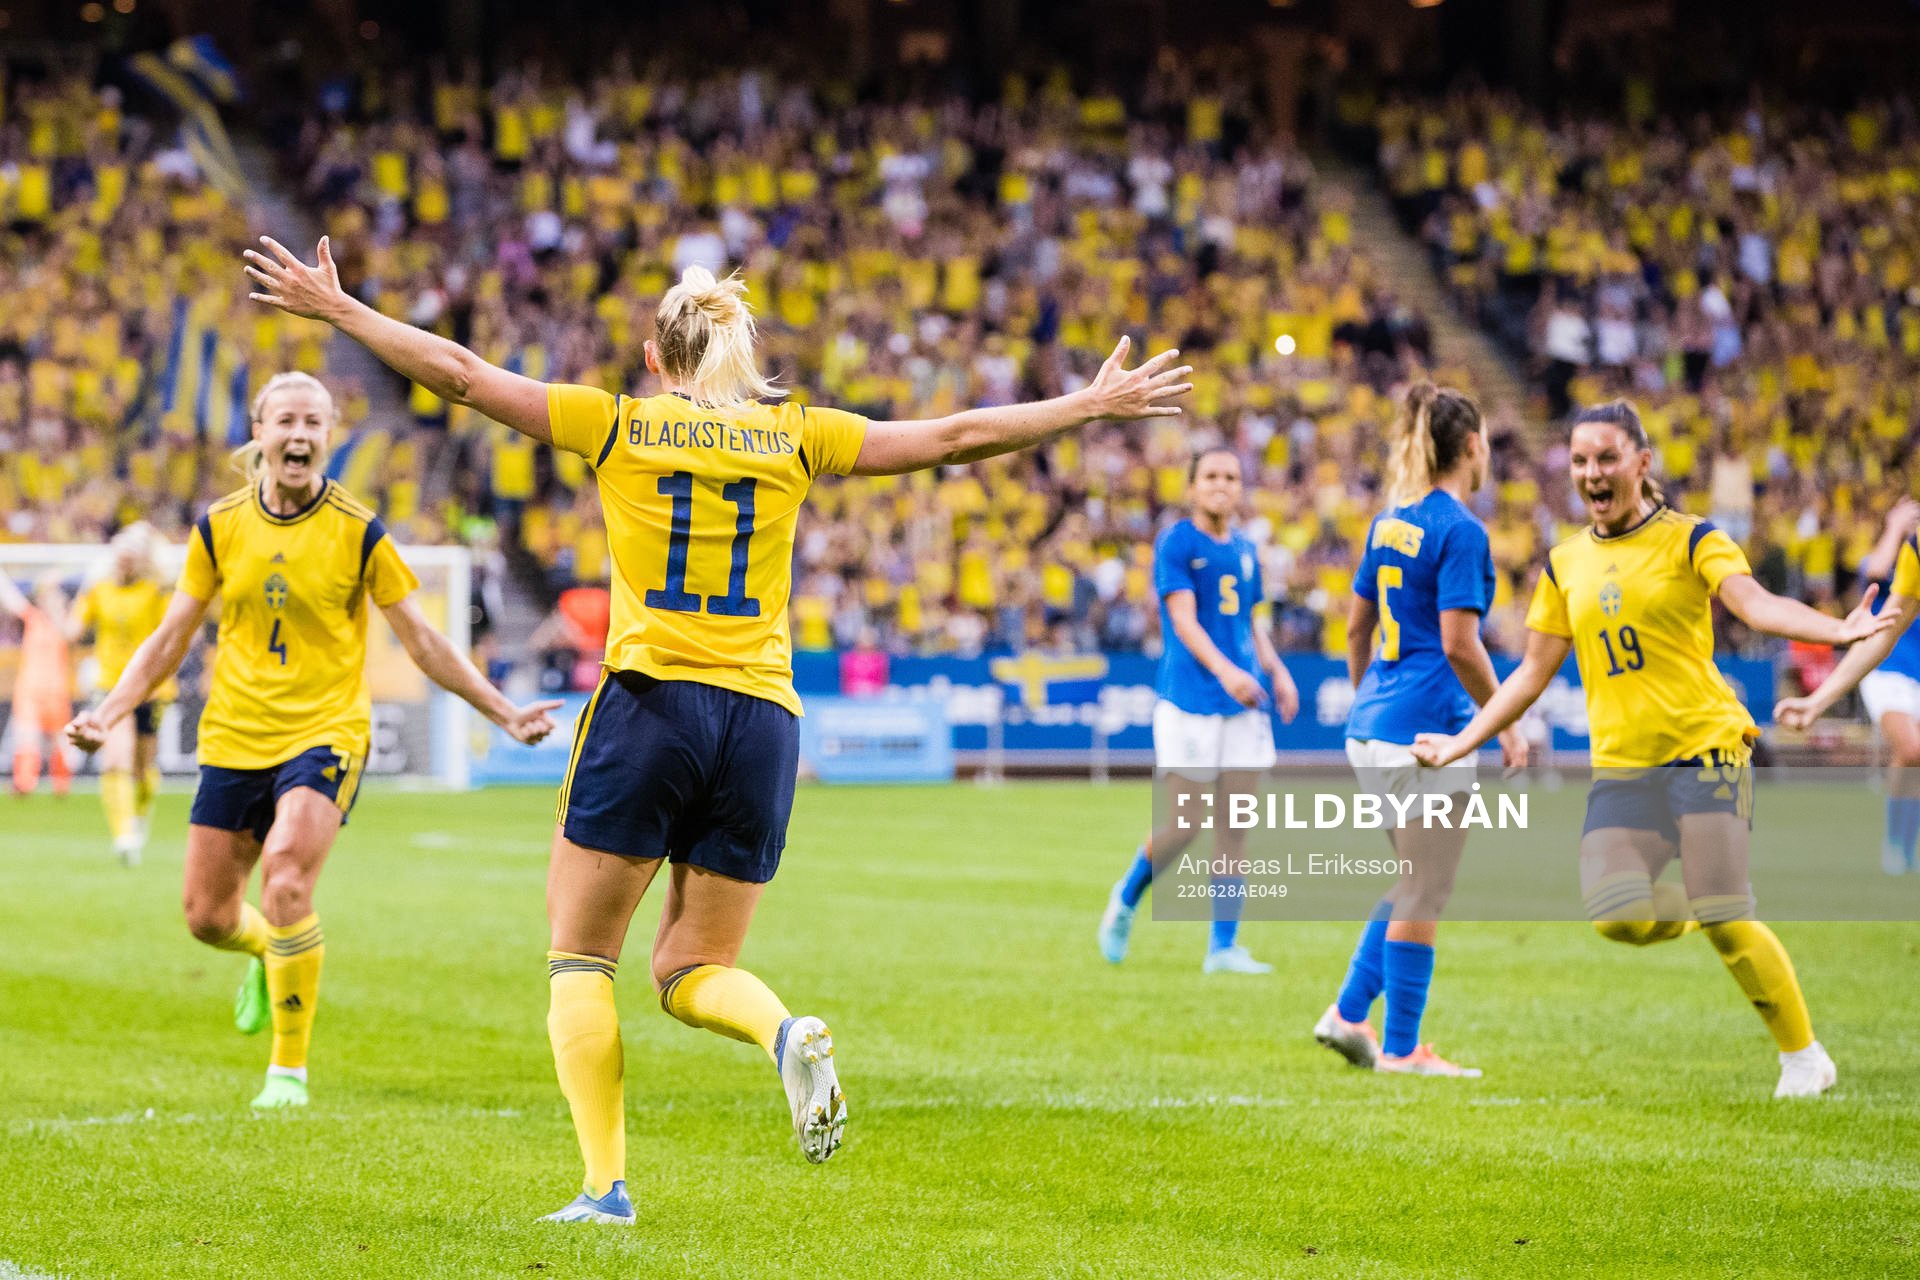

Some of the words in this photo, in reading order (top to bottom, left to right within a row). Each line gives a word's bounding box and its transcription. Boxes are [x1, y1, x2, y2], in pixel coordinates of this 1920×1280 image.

[629, 419, 794, 455] BLACKSTENIUS
[645, 471, 760, 617] 11
[1219, 574, 1239, 616] 5
[269, 618, 286, 665] 4
[1599, 625, 1645, 676] 19
